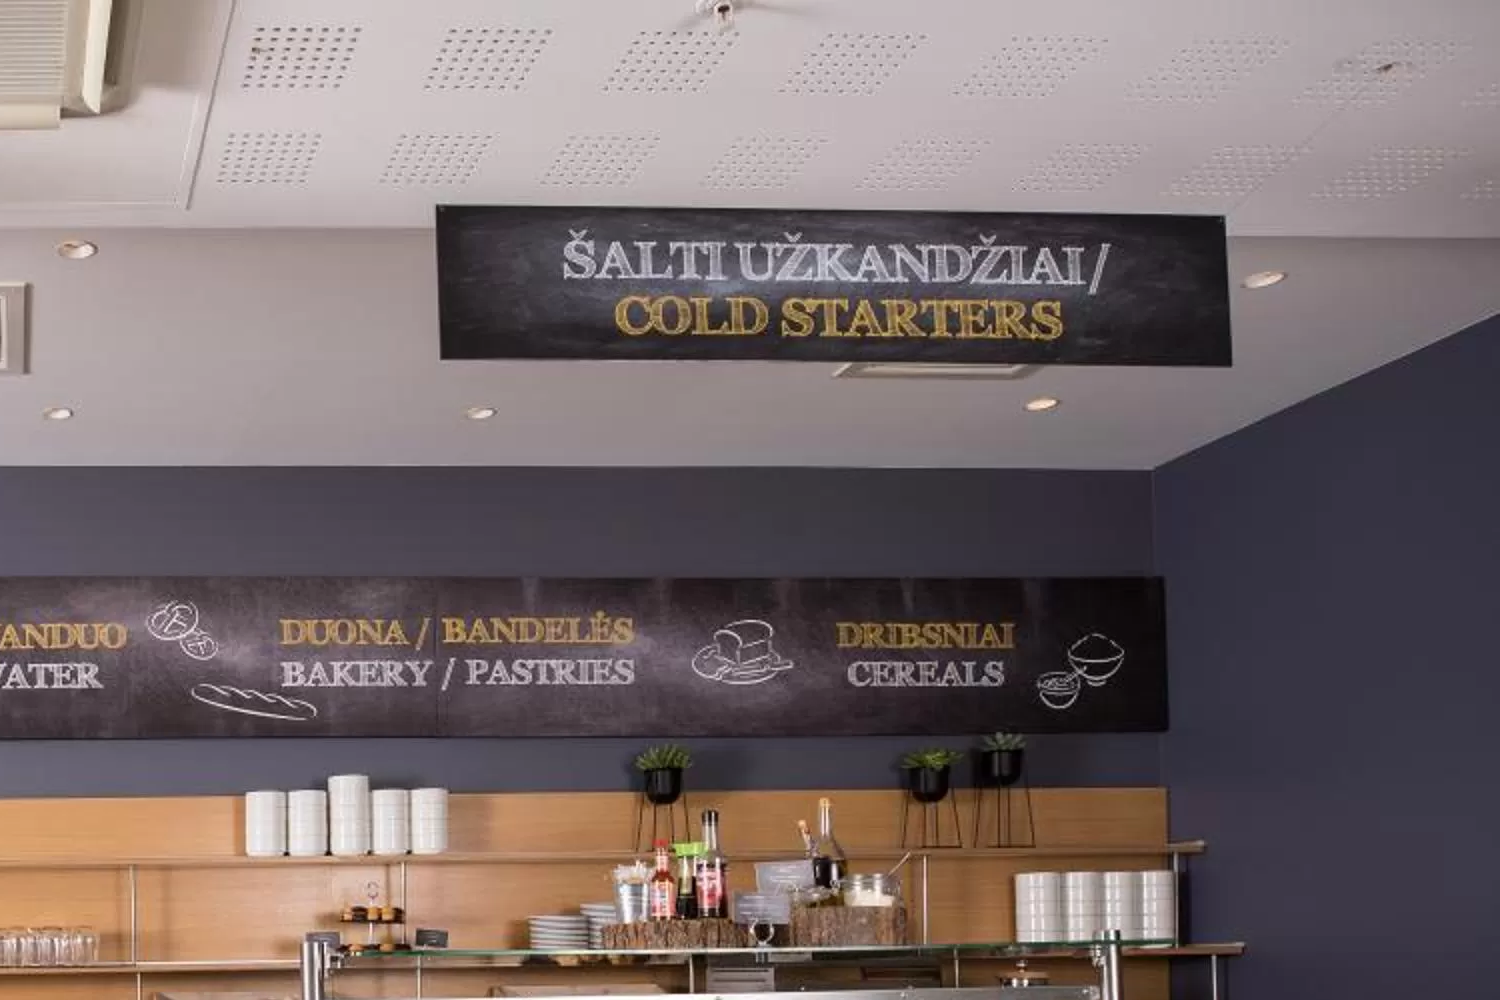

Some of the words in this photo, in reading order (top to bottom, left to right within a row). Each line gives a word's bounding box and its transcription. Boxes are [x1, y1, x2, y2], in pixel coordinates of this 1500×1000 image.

[562, 229, 726, 280] ŠALTI
[614, 296, 769, 336] COLD
[780, 298, 1064, 340] STARTERS
[279, 617, 410, 649] DUONA
[441, 610, 636, 648] BANDELĖS
[836, 622, 1015, 649] DRIBSNIAI
[280, 659, 433, 689] BAKERY
[465, 656, 637, 687] PASTRIES
[847, 661, 1005, 688] CEREALS
